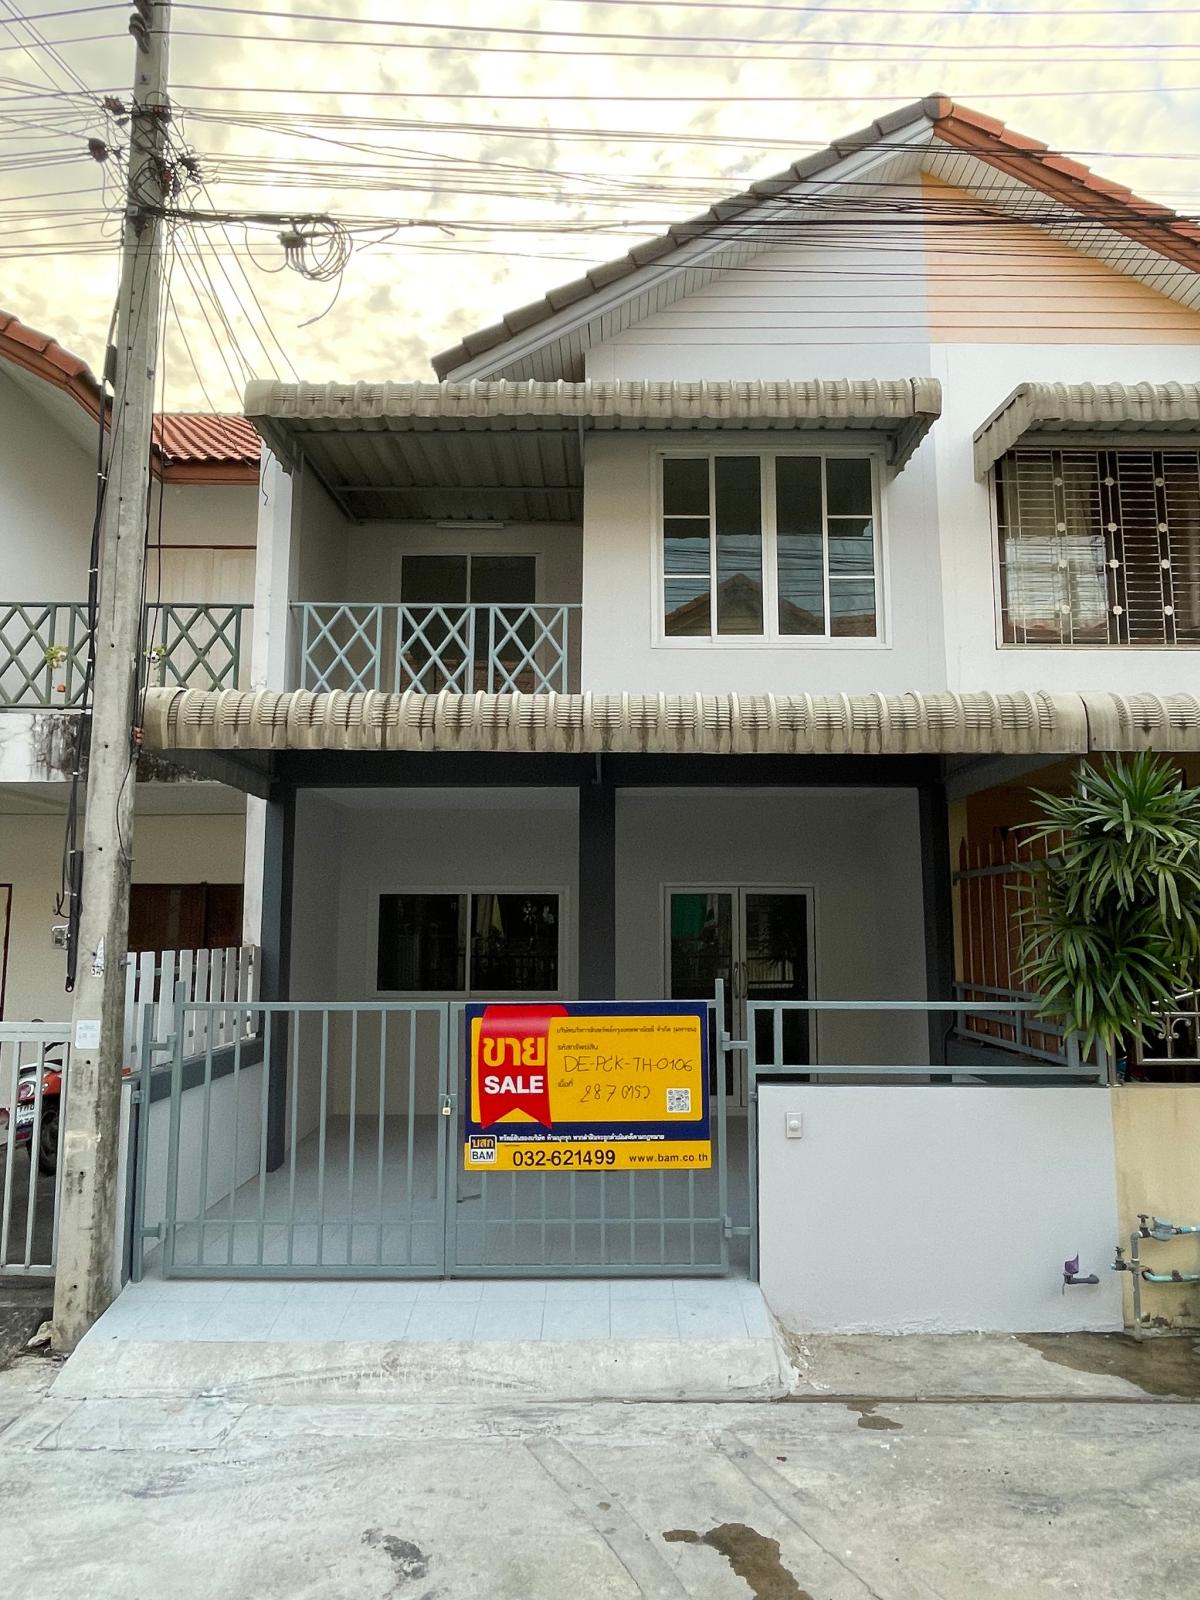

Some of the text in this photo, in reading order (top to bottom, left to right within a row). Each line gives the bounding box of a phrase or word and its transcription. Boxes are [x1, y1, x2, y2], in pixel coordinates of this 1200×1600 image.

[483, 1037, 545, 1067] ขาย
[484, 1075, 544, 1094] SALE
[471, 1138, 494, 1148] บสก
[472, 1150, 494, 1160] BAM
[512, 1149, 616, 1167] 032-621499
[629, 1153, 708, 1163] www.bam.co.th
